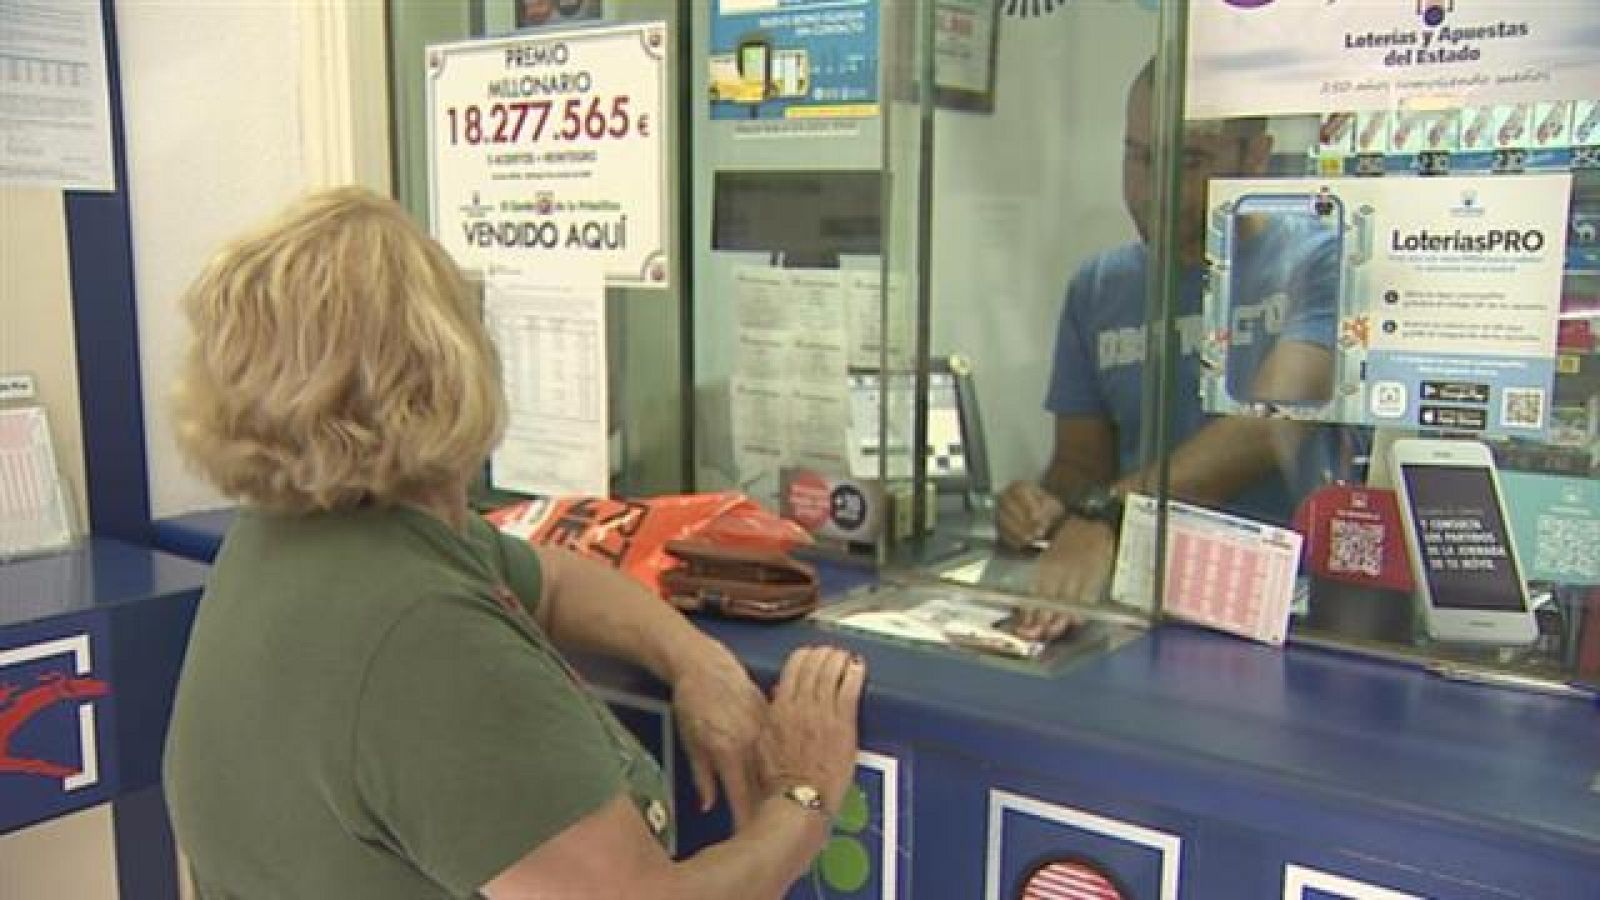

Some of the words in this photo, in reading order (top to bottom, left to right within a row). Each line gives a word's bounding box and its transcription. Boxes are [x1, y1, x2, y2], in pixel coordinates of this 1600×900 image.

[1344, 29, 1417, 48] Loterías
[1423, 31, 1433, 48] y
[1439, 21, 1528, 44] Apuestas
[505, 43, 569, 68] PREMIO
[1385, 49, 1412, 66] del
[1416, 46, 1481, 65] Estado
[488, 71, 591, 99] MILLONARIO
[447, 95, 630, 145] 18.277.565
[638, 113, 650, 137] €
[462, 220, 560, 250] VENDIDO
[564, 213, 628, 250] AQUÍ
